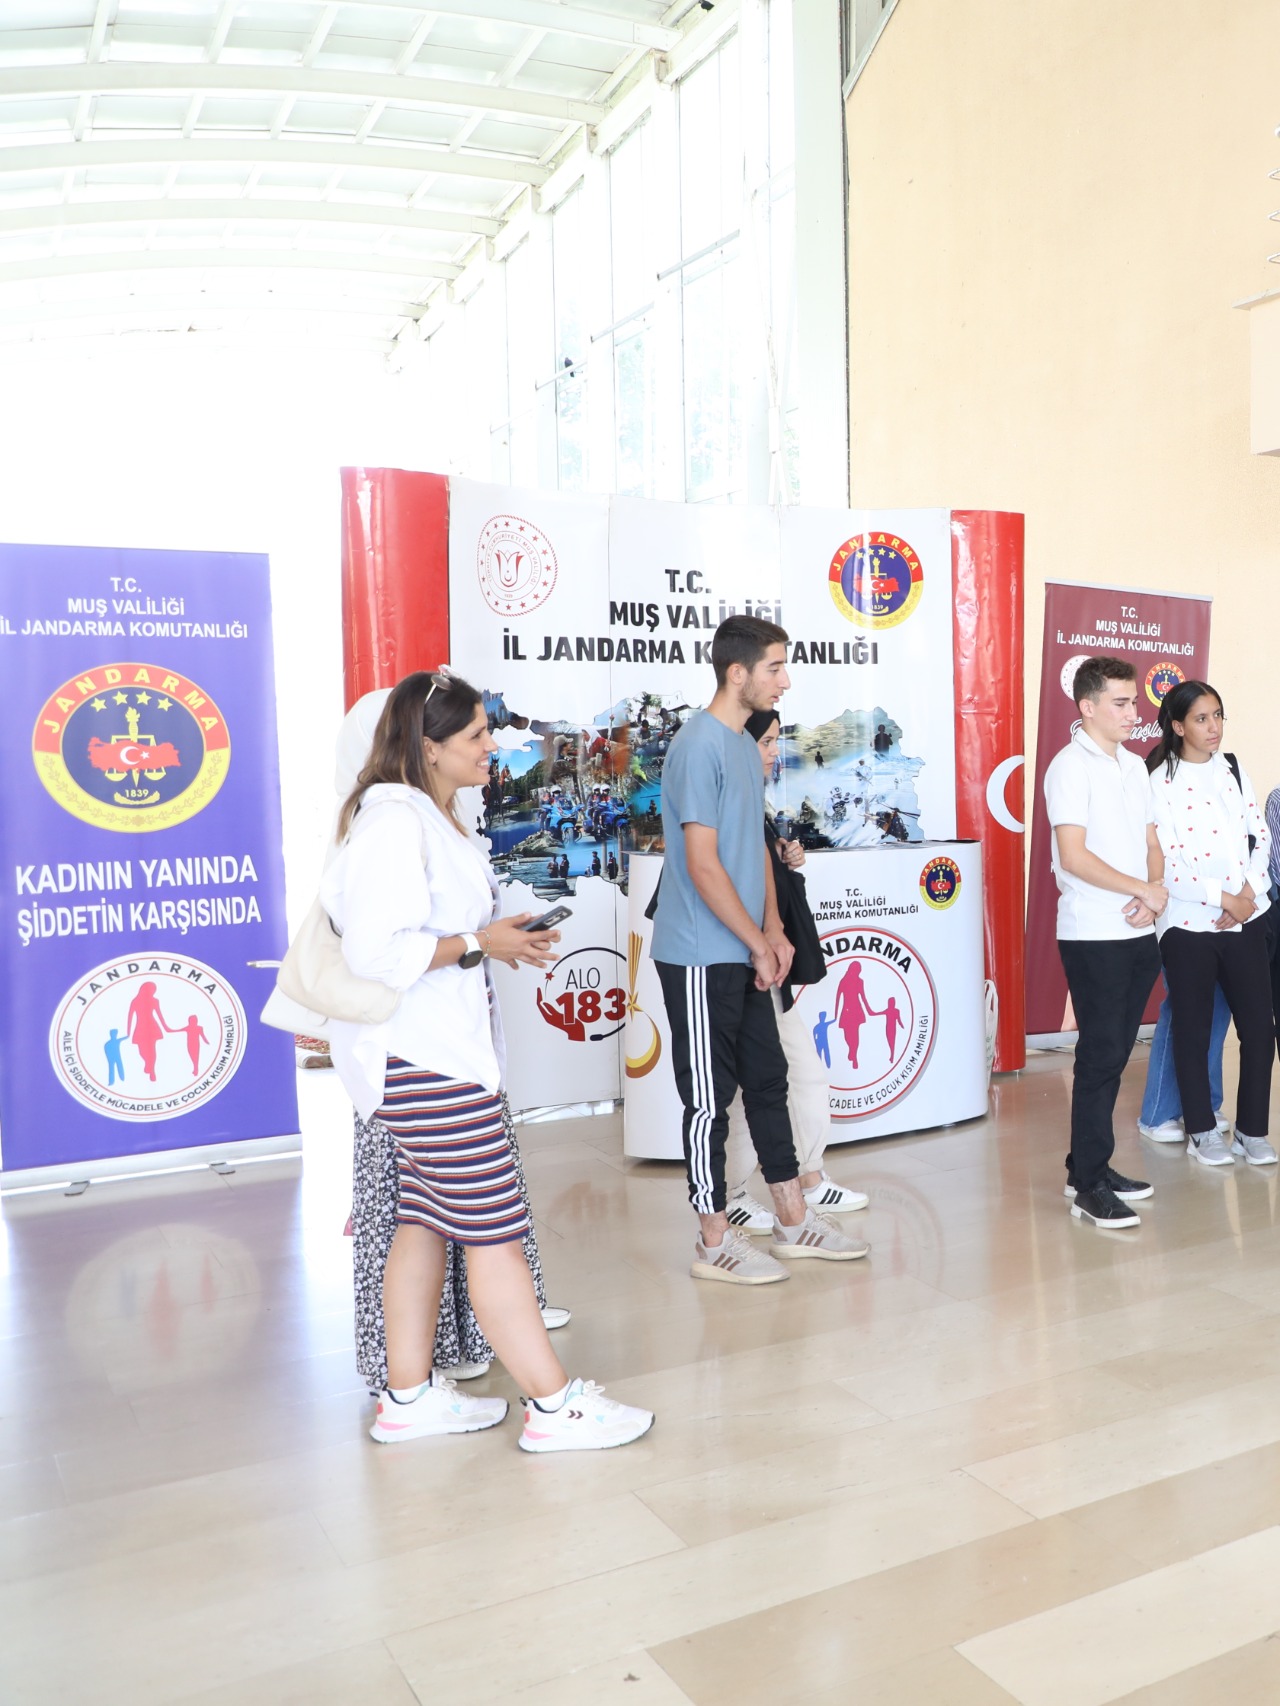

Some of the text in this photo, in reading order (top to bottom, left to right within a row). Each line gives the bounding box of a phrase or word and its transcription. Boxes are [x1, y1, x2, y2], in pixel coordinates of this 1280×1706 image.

[110, 577, 142, 592] T.C.
[665, 569, 712, 594] T.C.
[68, 597, 185, 617] MUŞ VALİLİĞİ
[610, 601, 660, 633] MUŞ
[1121, 606, 1138, 618] T.C.
[0, 616, 248, 639] İL JANDARMA KOMUTANLIĞI
[1096, 620, 1161, 637] MUŞ VALİLİĞİ
[503, 628, 527, 661] İL
[536, 636, 686, 665] JANDARMA
[1057, 630, 1194, 656] İL JANDARMA KOMUTANLIĞI
[44, 668, 219, 734] JANDARMA
[124, 789, 149, 798] 1839
[16, 855, 258, 894] KADININ YANINDA
[922, 857, 960, 881] JANDARMA
[820, 897, 886, 911] MUŞ VALİLİĞİ
[845, 888, 862, 897] T.C.
[18, 896, 262, 946] ŞİDDETİN KARŞISINDA
[814, 905, 919, 921] DARMA KOMUTANLIĞI
[821, 935, 912, 973] NDARMA
[77, 960, 217, 1006] JANDARMA
[565, 967, 601, 990] ALO
[556, 988, 626, 1024] 183
[63, 1031, 72, 1052] AİLE
[69, 1066, 105, 1102] ŞİDDETLE
[106, 1097, 164, 1112] MÜCADELE
[166, 1098, 180, 1108] VE
[181, 1079, 212, 1103] ÇOCUK
[212, 1056, 229, 1080] KISIM
[223, 1015, 234, 1055] AMİRLİĞİ
[829, 1015, 929, 1109] CADELE VE ÇOCUK KISIM AMİRLİĞİ
